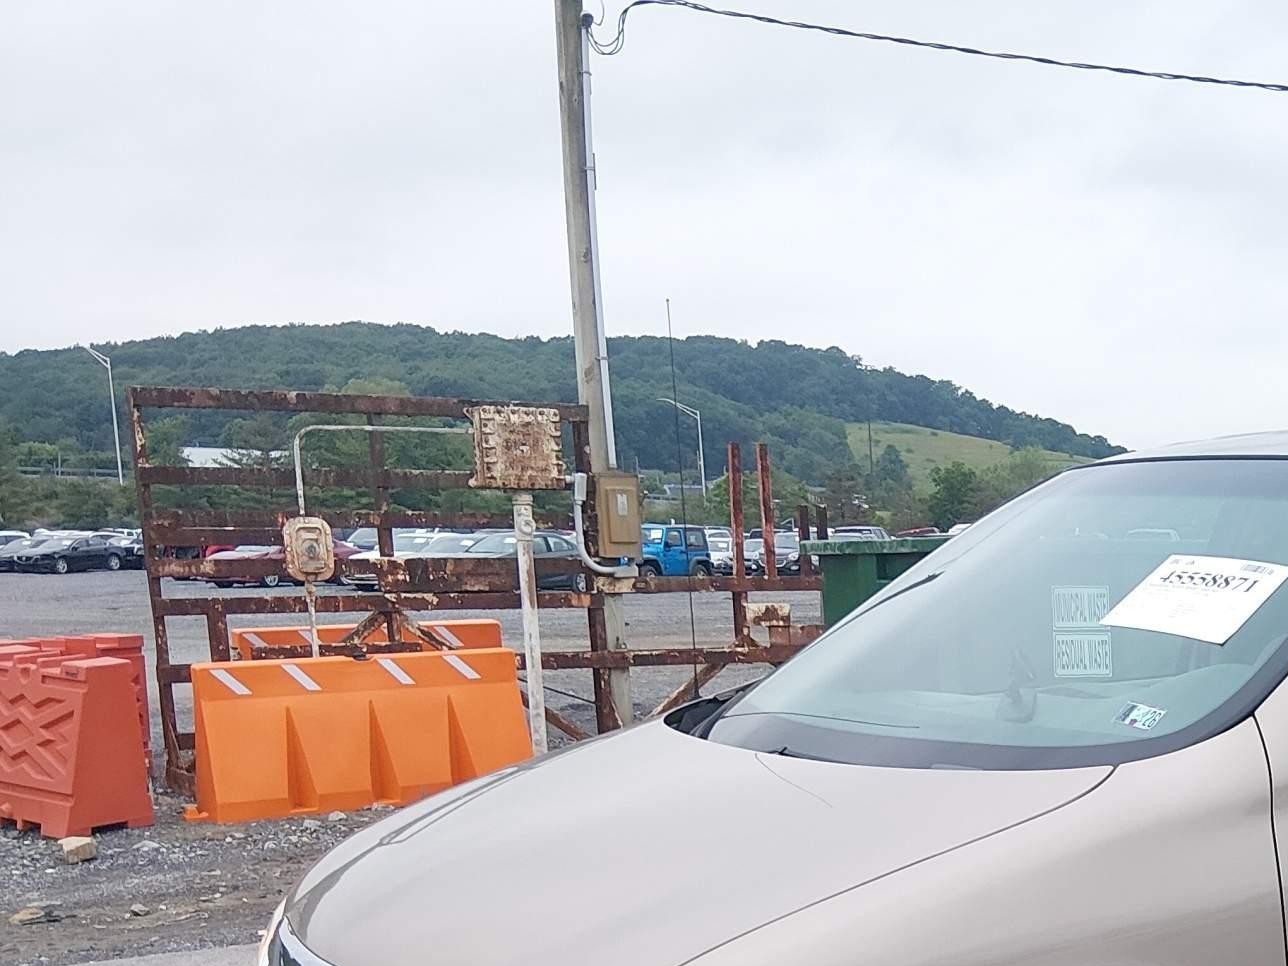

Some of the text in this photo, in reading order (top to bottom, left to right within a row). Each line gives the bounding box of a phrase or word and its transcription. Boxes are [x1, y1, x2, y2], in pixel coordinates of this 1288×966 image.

[1160, 570, 1259, 593] 45558871
[1056, 639, 1109, 670] RESIDUAL WASTE
